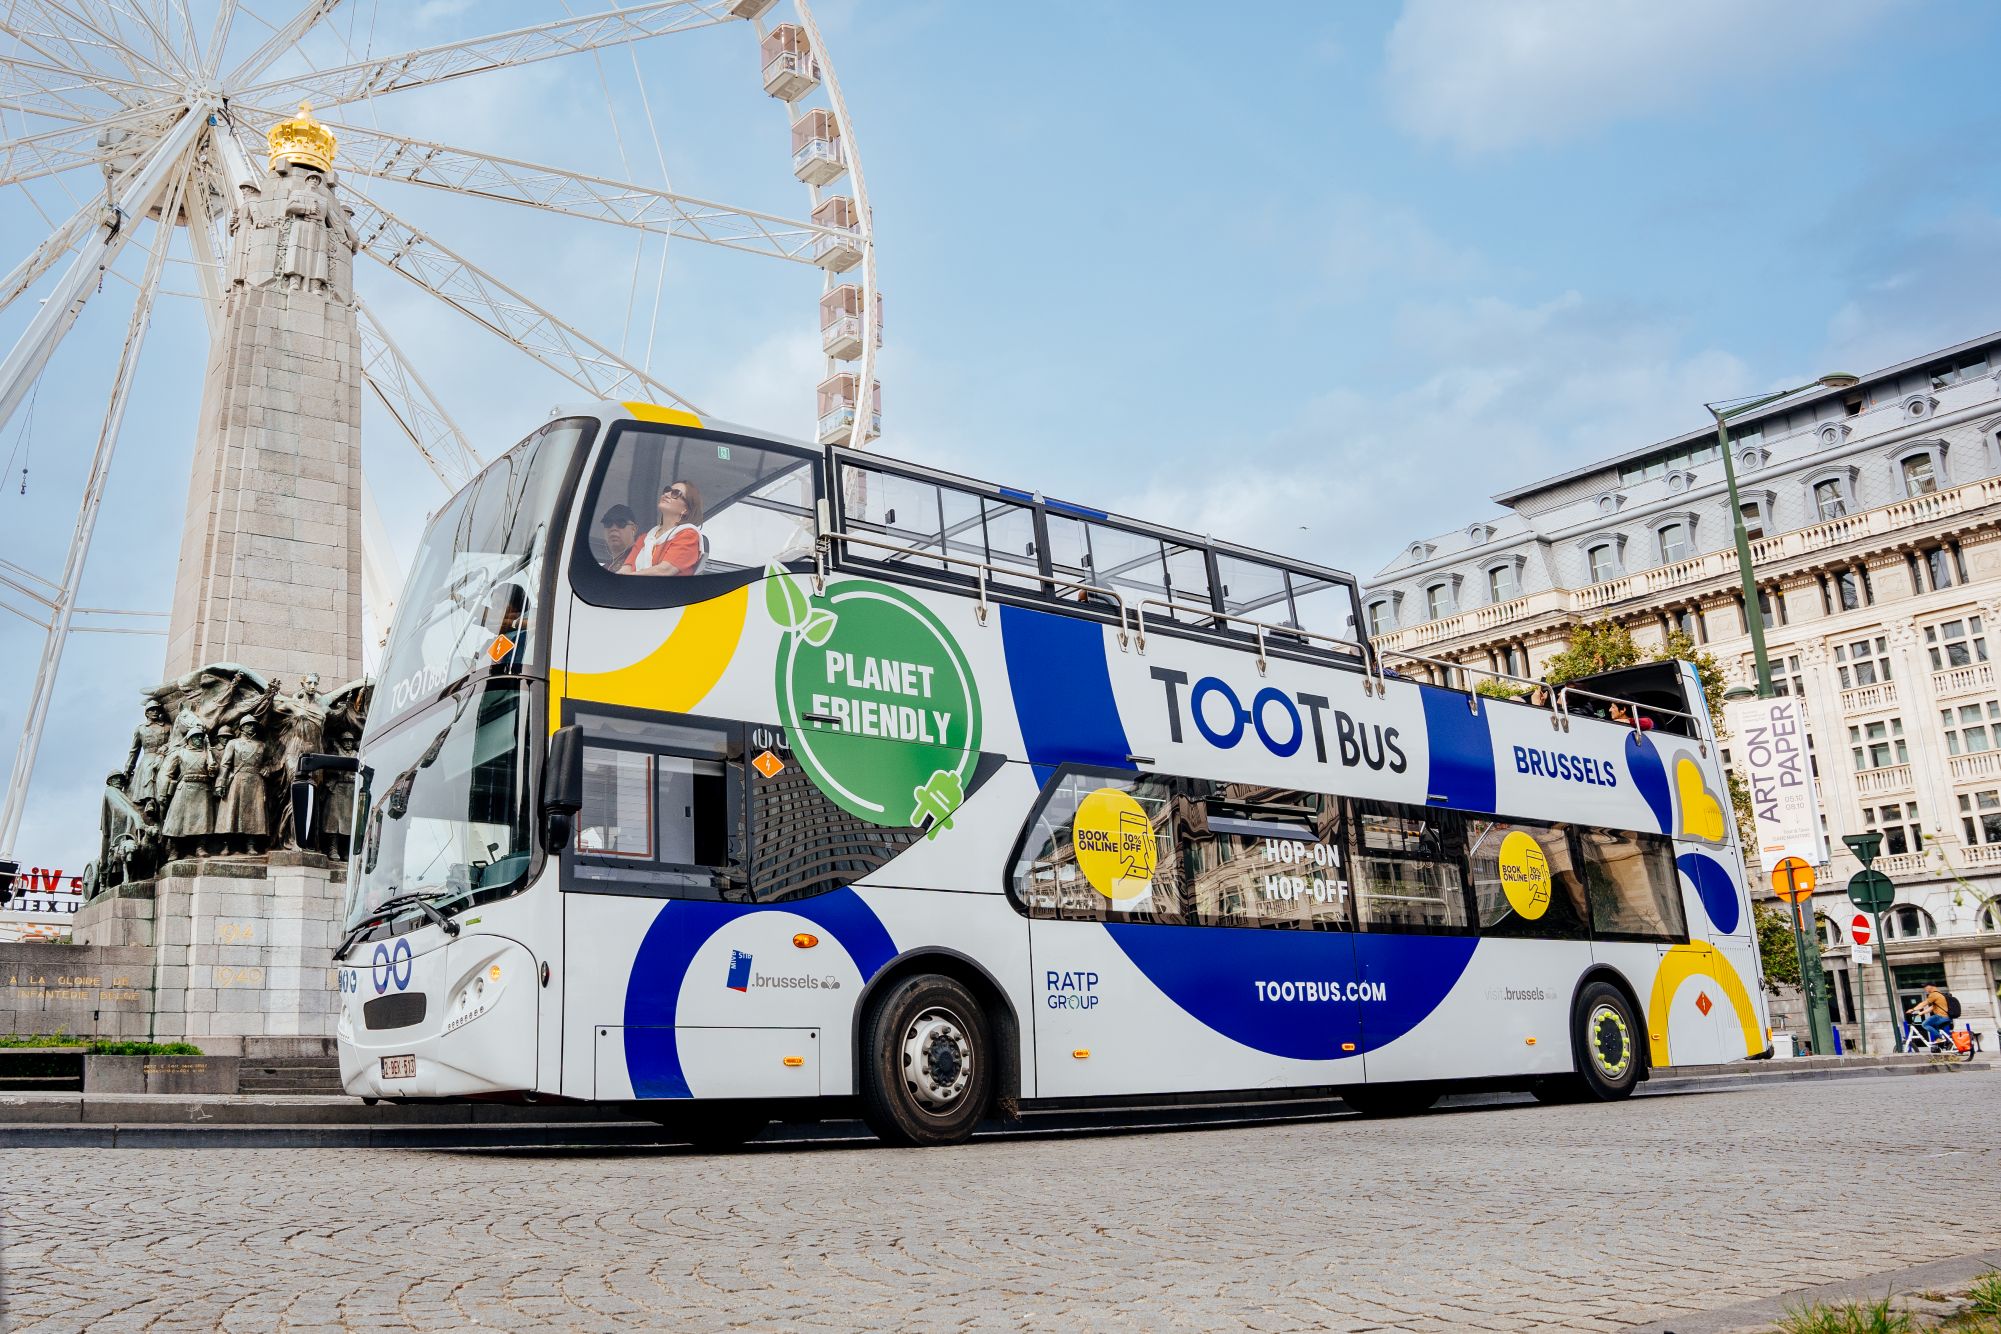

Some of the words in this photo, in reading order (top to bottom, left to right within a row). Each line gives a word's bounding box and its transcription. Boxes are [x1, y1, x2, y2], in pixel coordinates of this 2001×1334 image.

[825, 650, 934, 698] PLANET
[812, 693, 951, 745] FRIENDLY
[1149, 665, 1407, 774] TOOTBUS
[1745, 726, 1772, 768] ON
[1770, 702, 1804, 788] PAPER
[1513, 745, 1617, 788] BRUSSELS
[1752, 772, 1781, 824] ART
[1078, 830, 1109, 842] BOOK
[1079, 840, 1119, 853] ONLINE
[1124, 833, 1142, 845] 10%
[1123, 842, 1142, 853] OFF
[1265, 838, 1341, 868] HOP-ON
[1502, 864, 1522, 874] BOOK
[1503, 873, 1528, 882] ONLINE
[1529, 873, 1542, 882] OFF
[1264, 875, 1349, 904] HOP-OFF
[738, 952, 752, 960] STIB
[9, 976, 17, 985] A
[29, 975, 46, 985] LA
[1046, 971, 1099, 992] RATP
[1255, 980, 1387, 1002] TOOTBUS.COM
[1047, 994, 1099, 1010] GROUP
